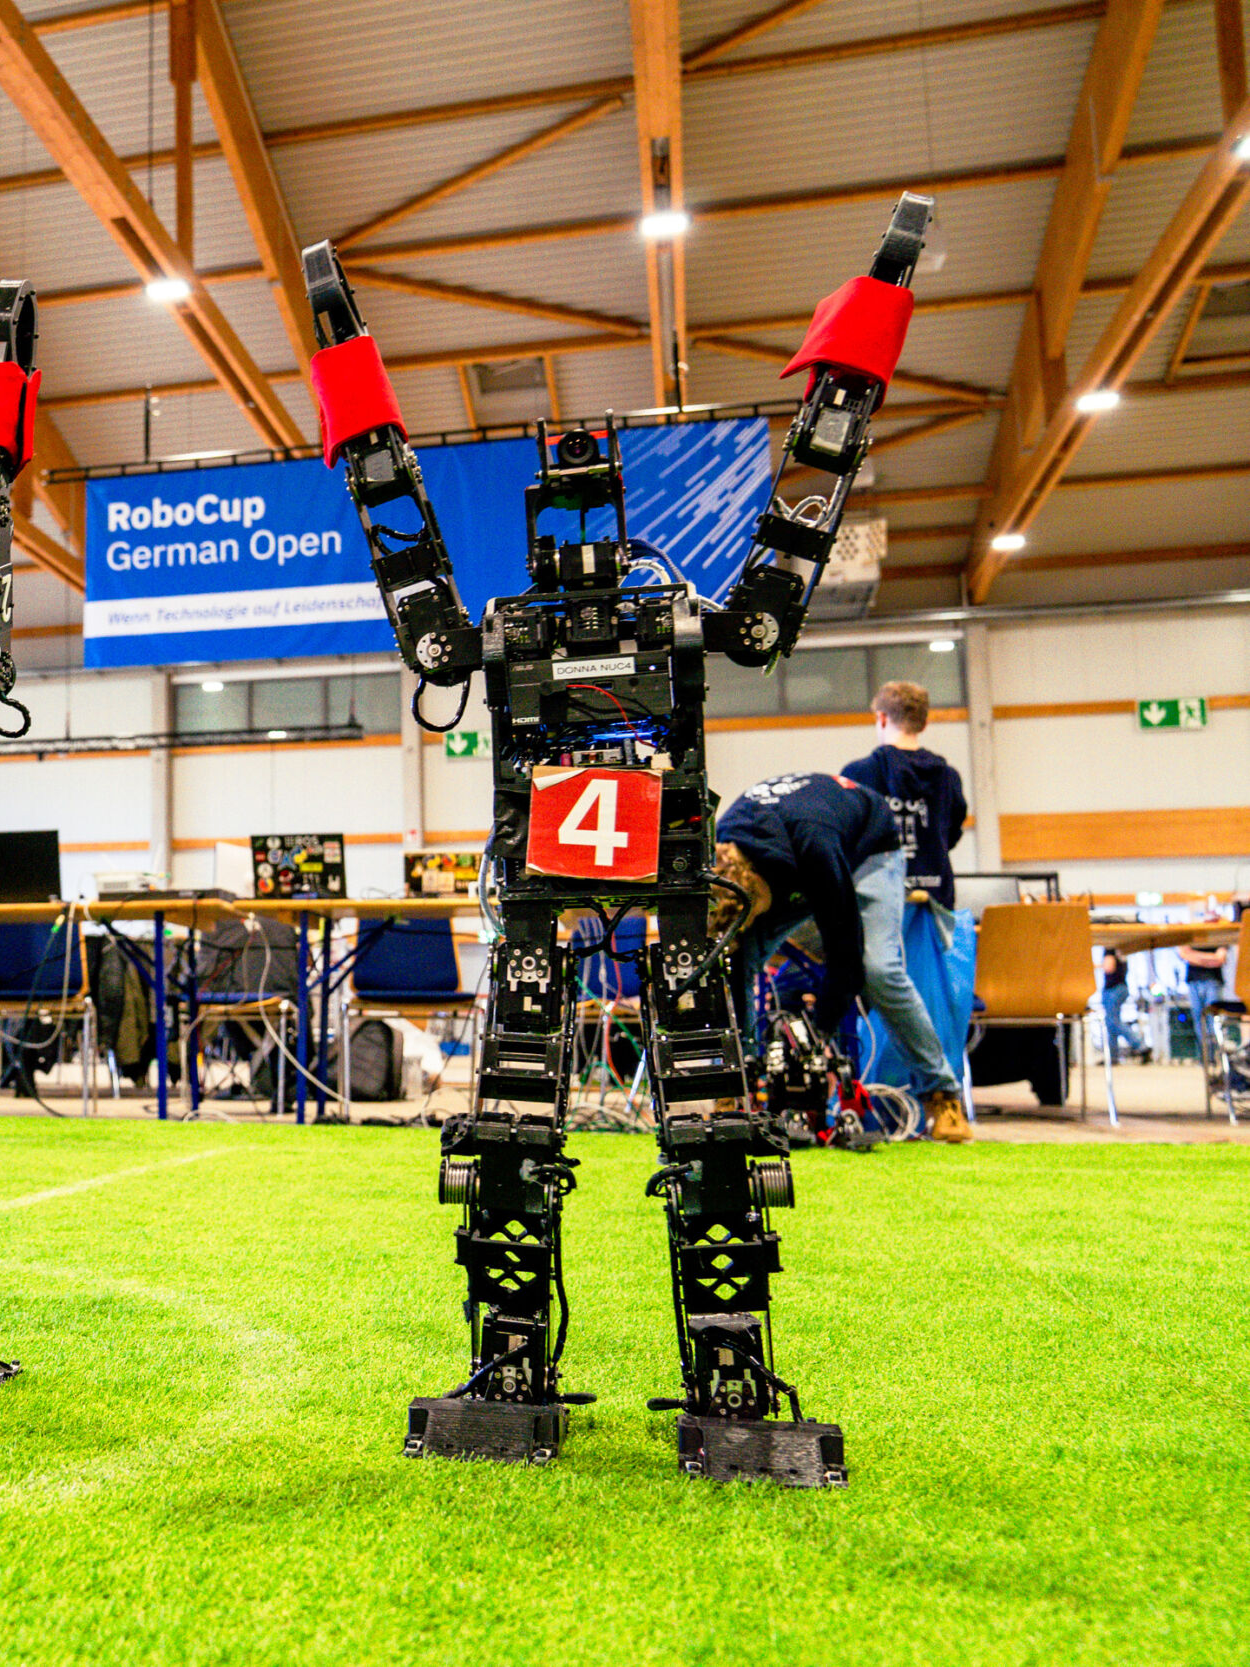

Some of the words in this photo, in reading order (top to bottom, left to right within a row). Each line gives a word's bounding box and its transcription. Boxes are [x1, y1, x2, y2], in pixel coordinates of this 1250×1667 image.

[107, 493, 266, 533] RoboCup
[106, 538, 239, 572] German
[250, 529, 342, 566] Open
[108, 609, 150, 625] Wenn
[156, 603, 249, 622] Technologie
[252, 599, 282, 618] auf
[284, 594, 383, 614] Leidenschaf
[556, 665, 598, 675] DONNA
[600, 662, 632, 672] NUC4
[557, 778, 629, 867] 4
